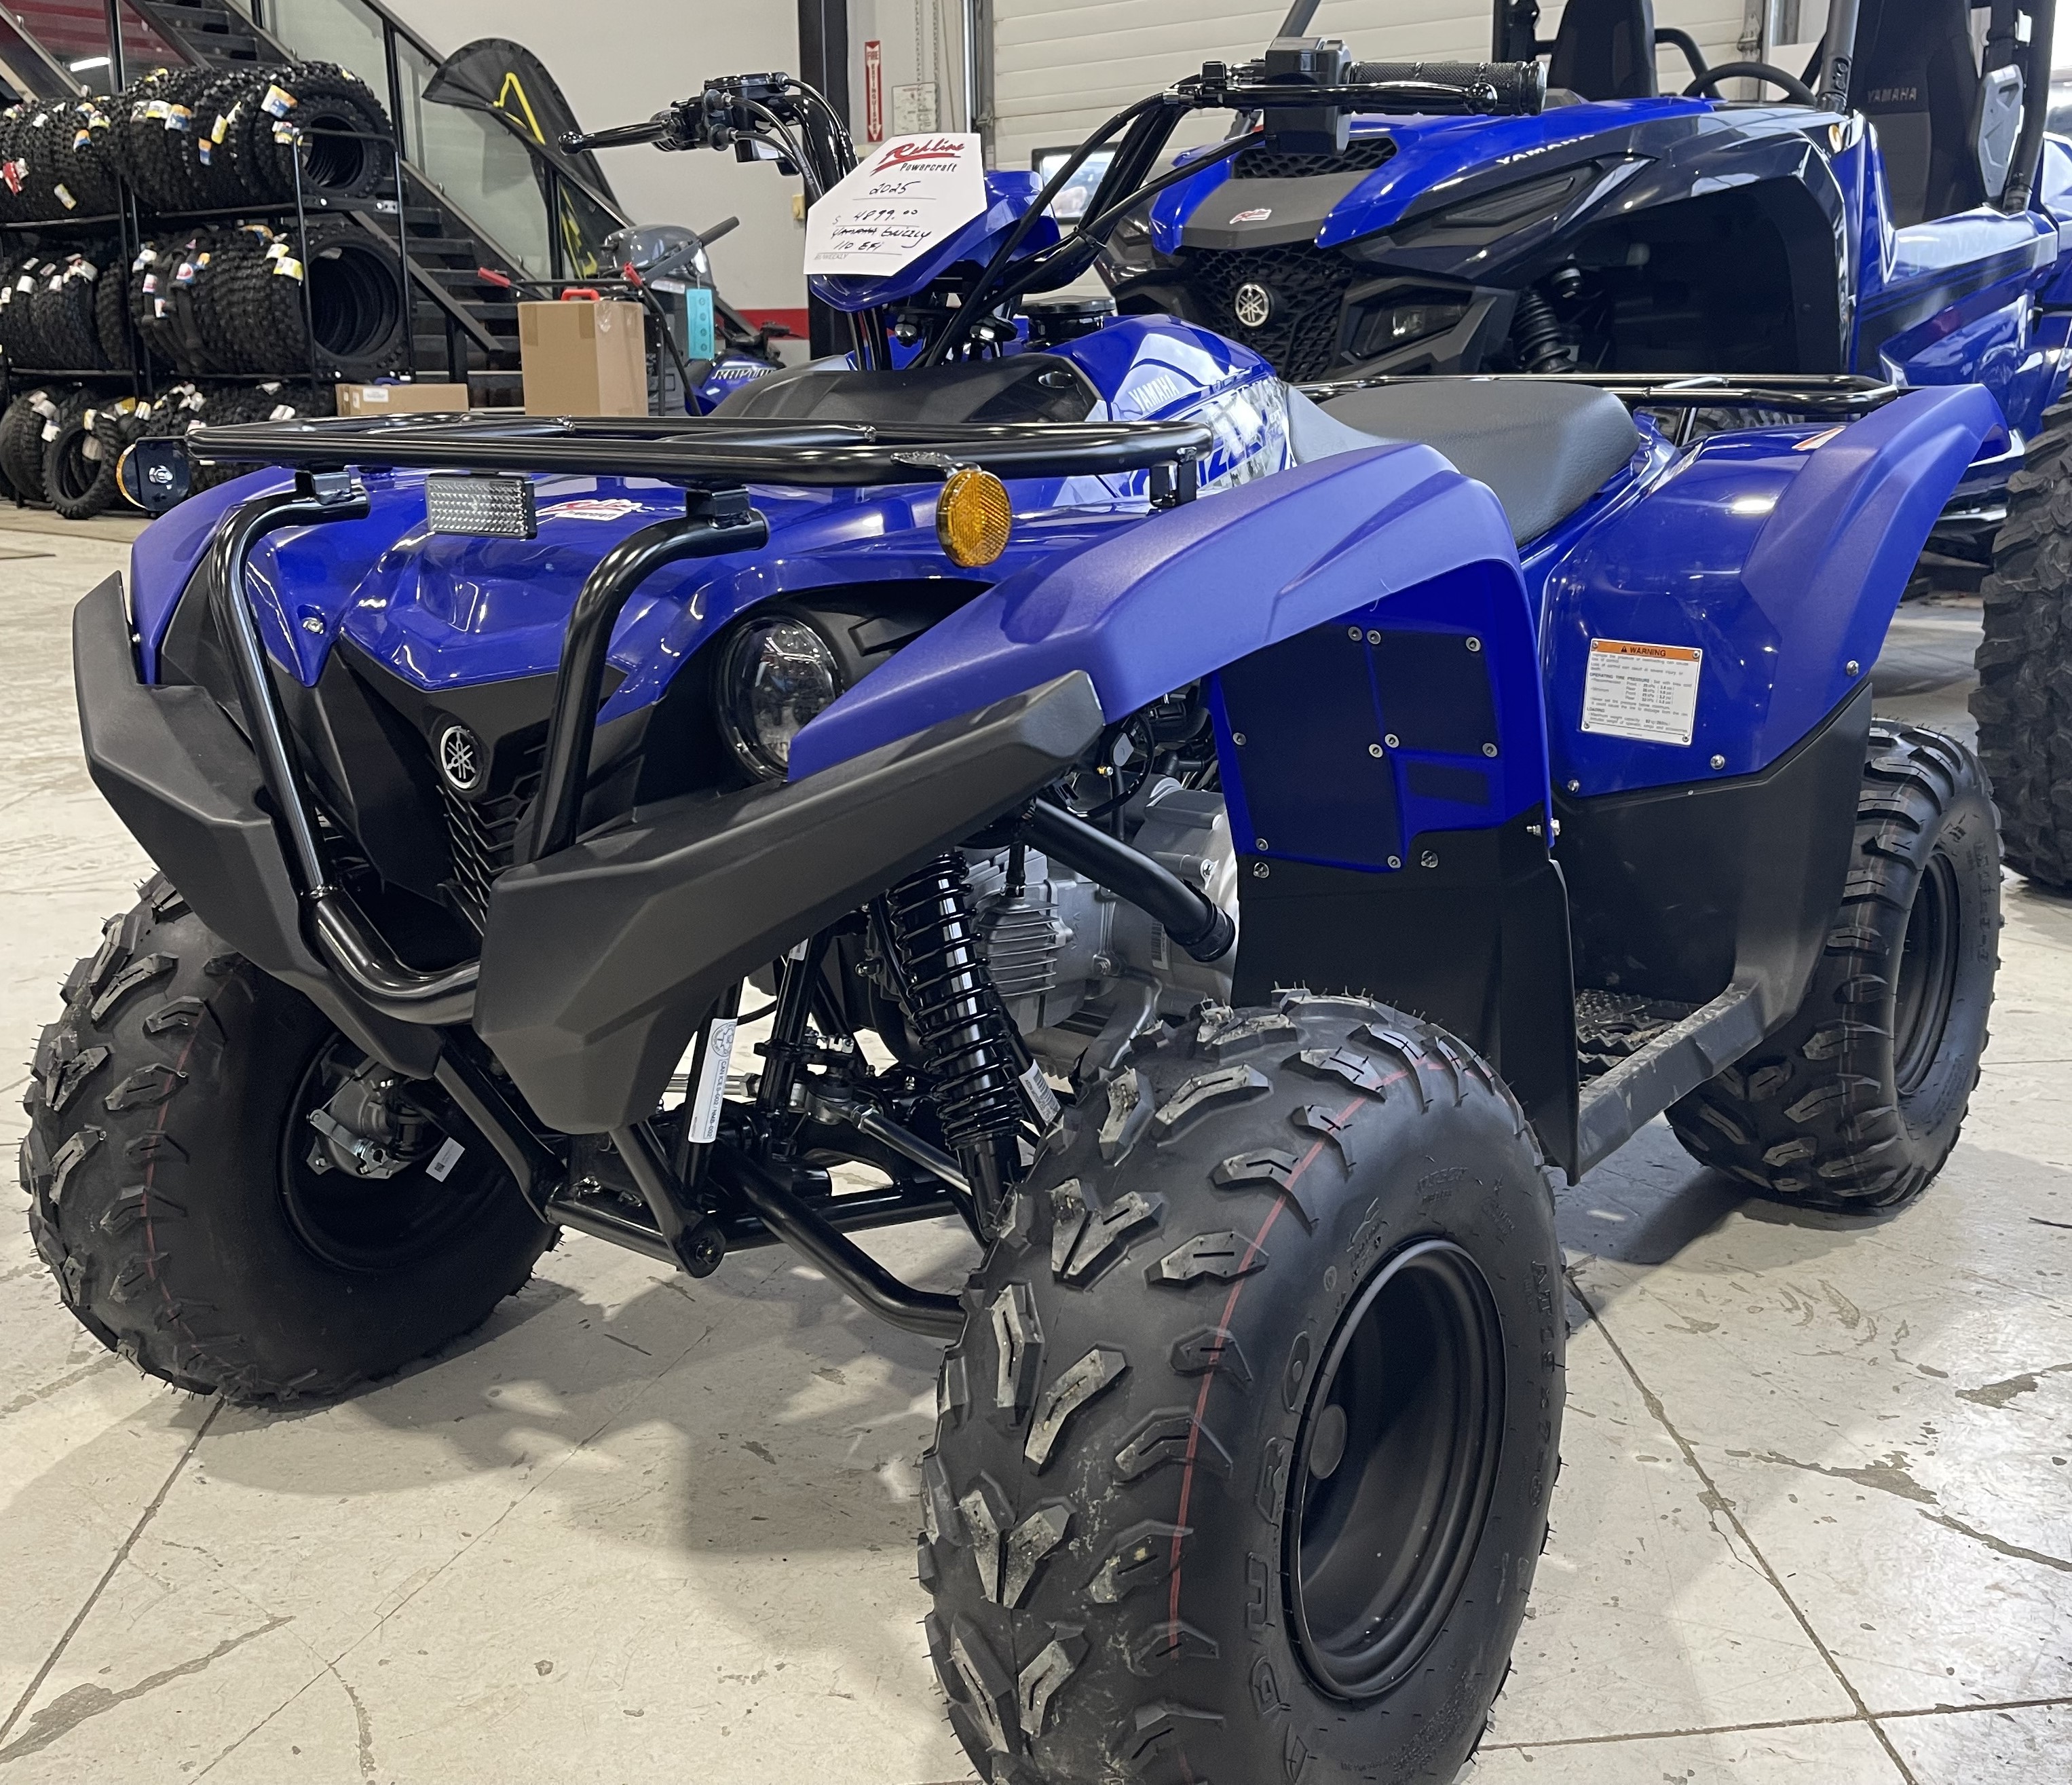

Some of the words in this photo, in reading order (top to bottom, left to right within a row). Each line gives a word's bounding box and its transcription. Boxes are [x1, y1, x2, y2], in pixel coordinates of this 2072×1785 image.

[867, 51, 879, 60] FIRE
[1868, 87, 1917, 102] YAMAHA
[899, 162, 957, 173] Powercraft
[869, 181, 921, 195] 2025
[833, 240, 852, 250] 110
[1128, 375, 1180, 411] YAMAHA
[1630, 647, 1666, 657] WARNING
